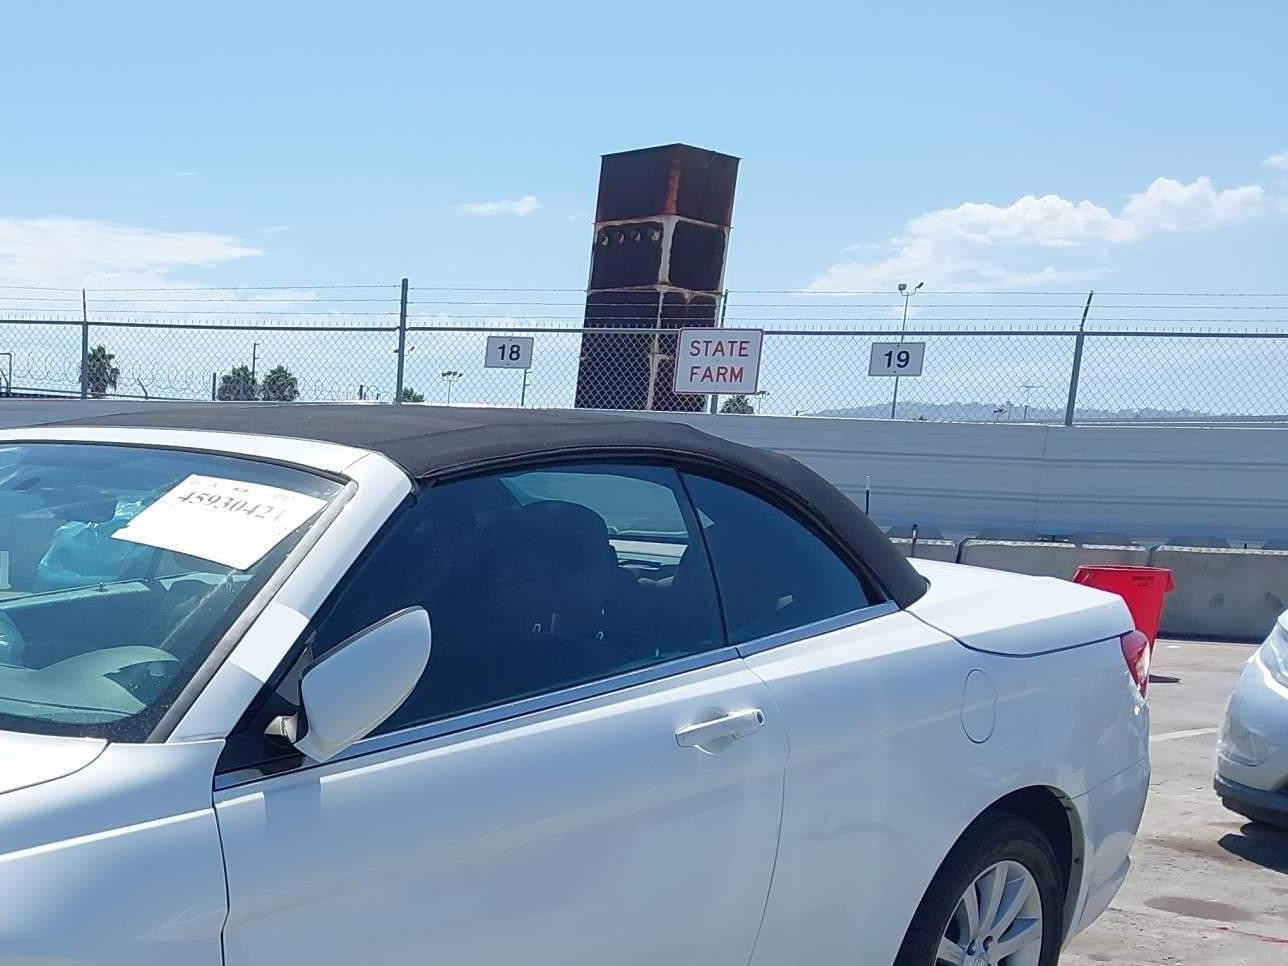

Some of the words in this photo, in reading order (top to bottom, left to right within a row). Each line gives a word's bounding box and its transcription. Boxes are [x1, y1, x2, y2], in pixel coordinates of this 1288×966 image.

[497, 344, 521, 361] 18
[689, 340, 750, 357] STATE
[884, 350, 910, 368] 19
[689, 366, 744, 383] FARM
